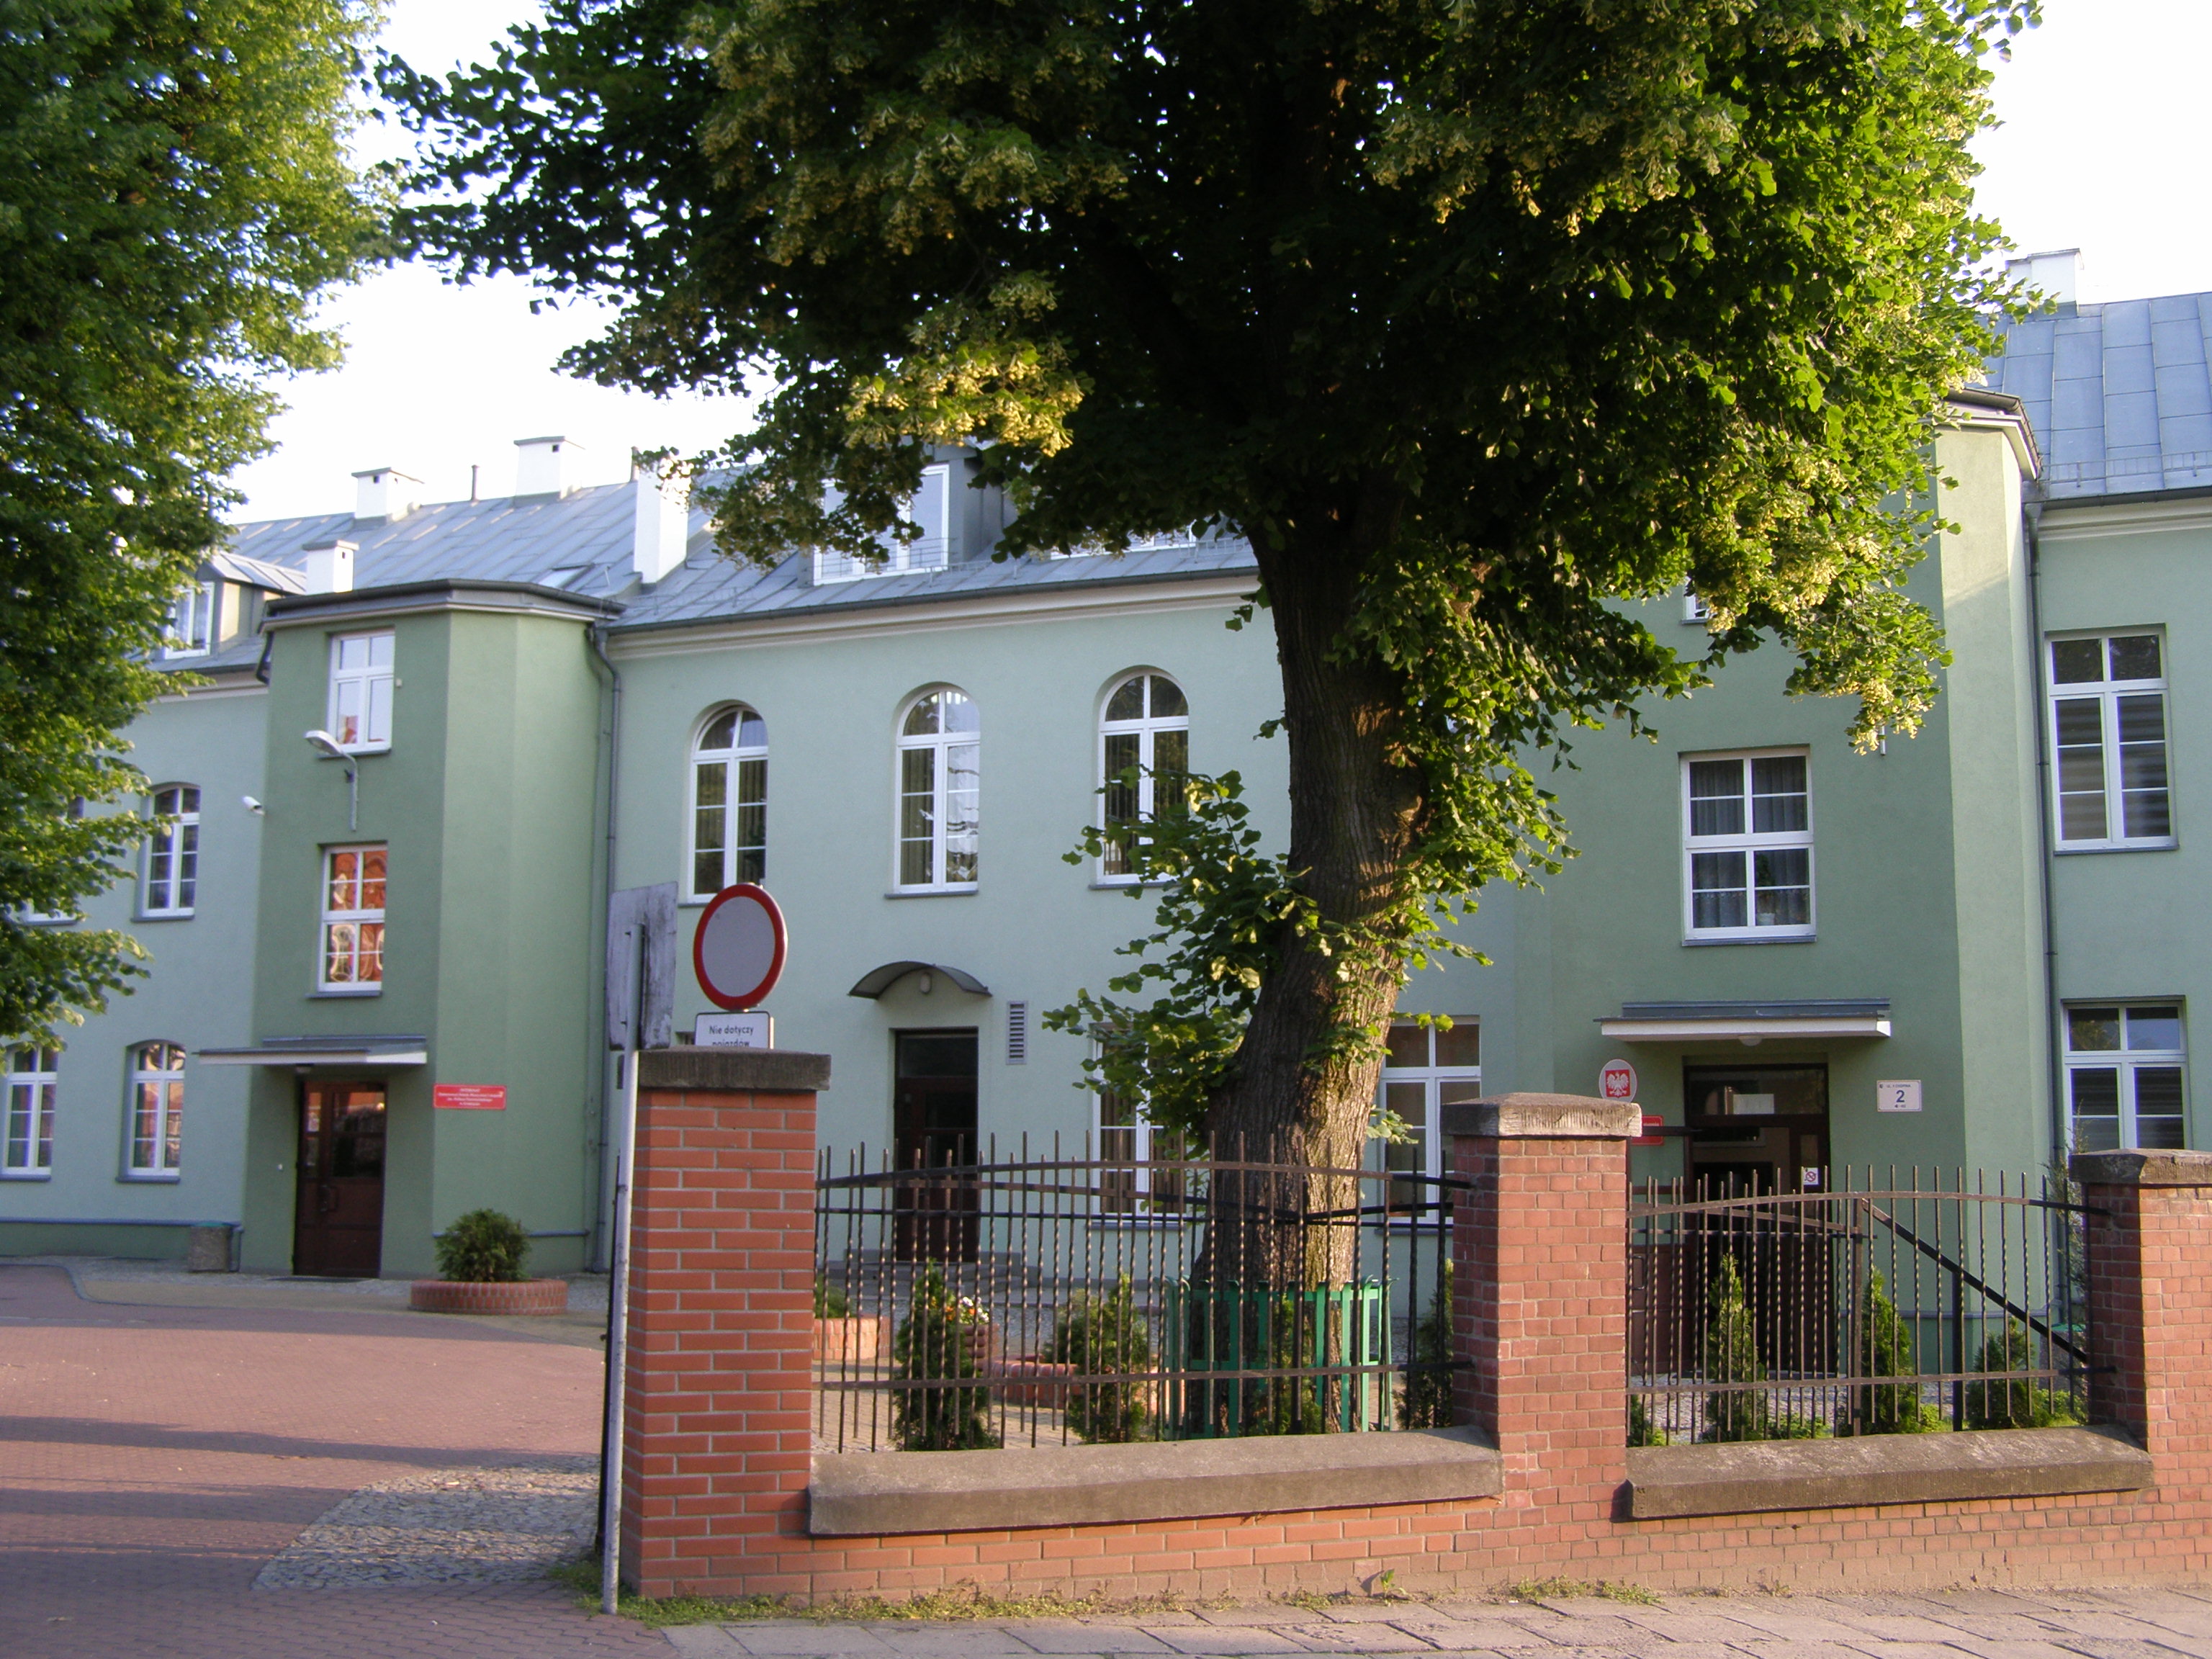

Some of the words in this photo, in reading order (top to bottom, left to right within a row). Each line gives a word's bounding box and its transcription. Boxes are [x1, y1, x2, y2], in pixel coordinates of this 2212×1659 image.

[709, 1025, 722, 1035] Nie
[724, 1025, 754, 1036] dotyczy
[1896, 1089, 1905, 1103] 2
